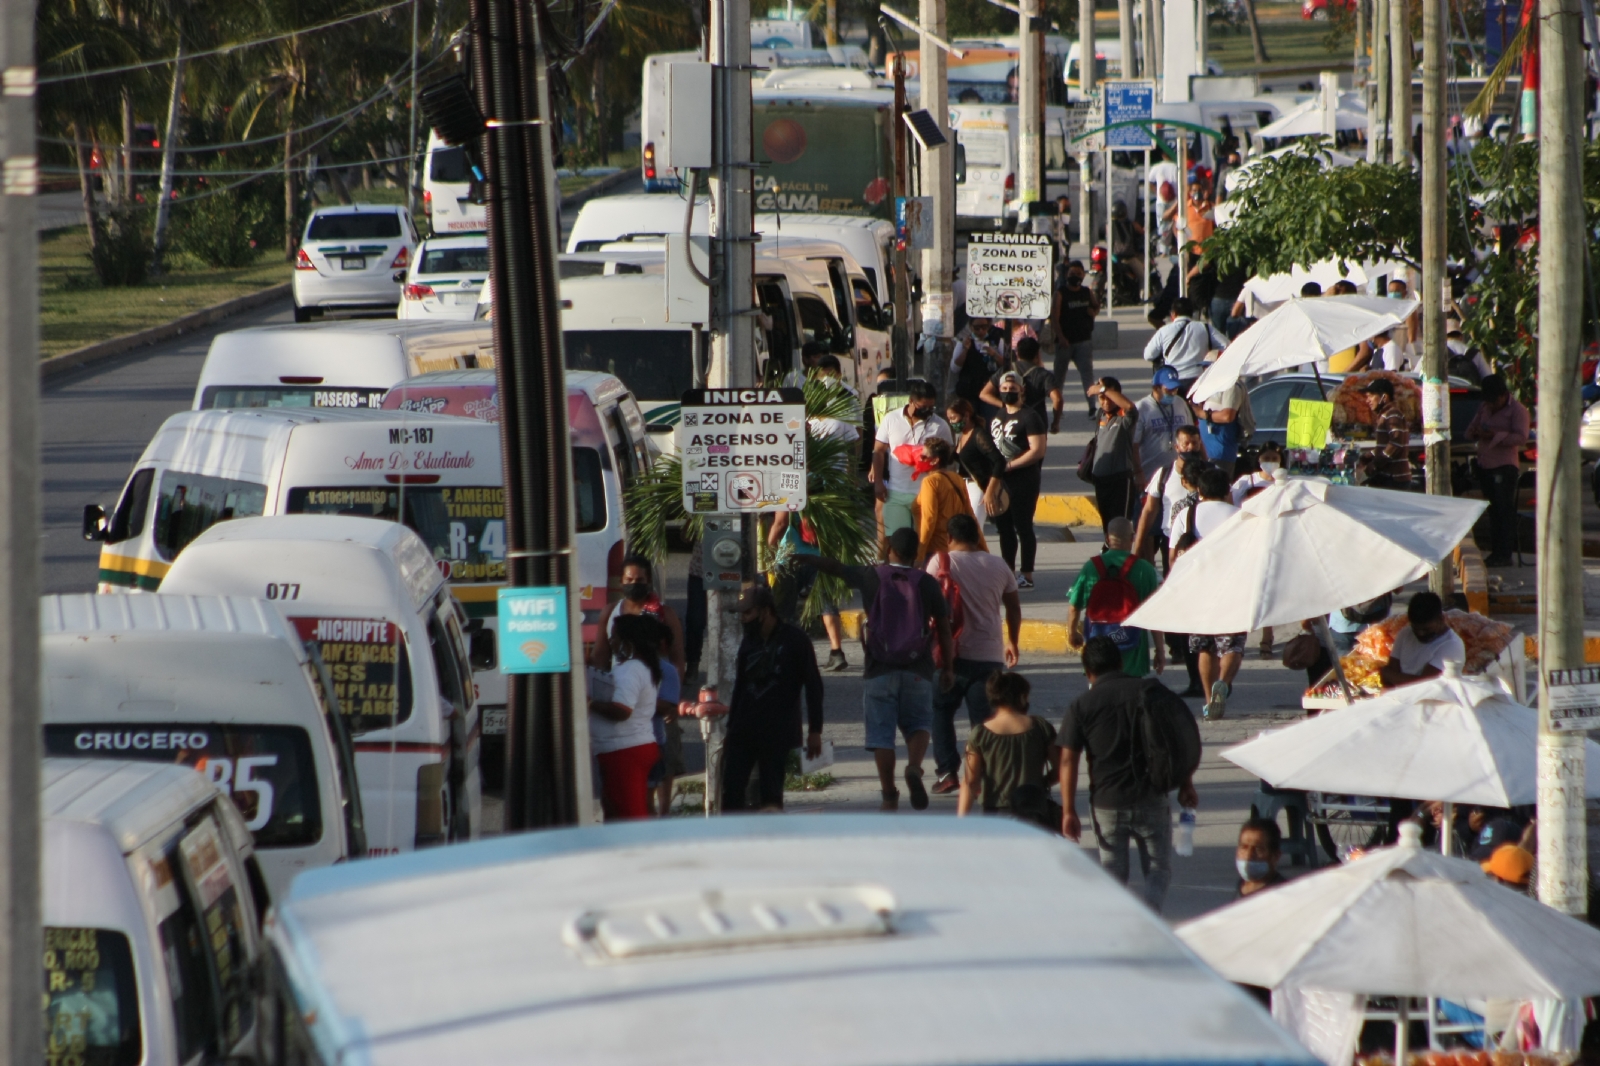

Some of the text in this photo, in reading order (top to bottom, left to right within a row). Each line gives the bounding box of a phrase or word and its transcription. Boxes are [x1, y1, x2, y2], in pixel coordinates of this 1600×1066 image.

[971, 232, 1050, 245] TERMINA
[982, 249, 1037, 259] ZONA DE
[981, 263, 1033, 273] SCENSO
[314, 391, 358, 408] PASEOS
[704, 390, 783, 404] INICIA
[702, 413, 784, 425] ZONA DE
[388, 428, 434, 444] MC-187
[691, 434, 797, 446] ASCENSO Y
[454, 488, 505, 503] AMERIC
[446, 503, 505, 518] TIANGU
[453, 563, 506, 579] CRUCE
[266, 582, 300, 600] 077
[508, 598, 555, 616] WiFi
[507, 619, 557, 634] Público
[75, 731, 209, 750] CRUCERO
